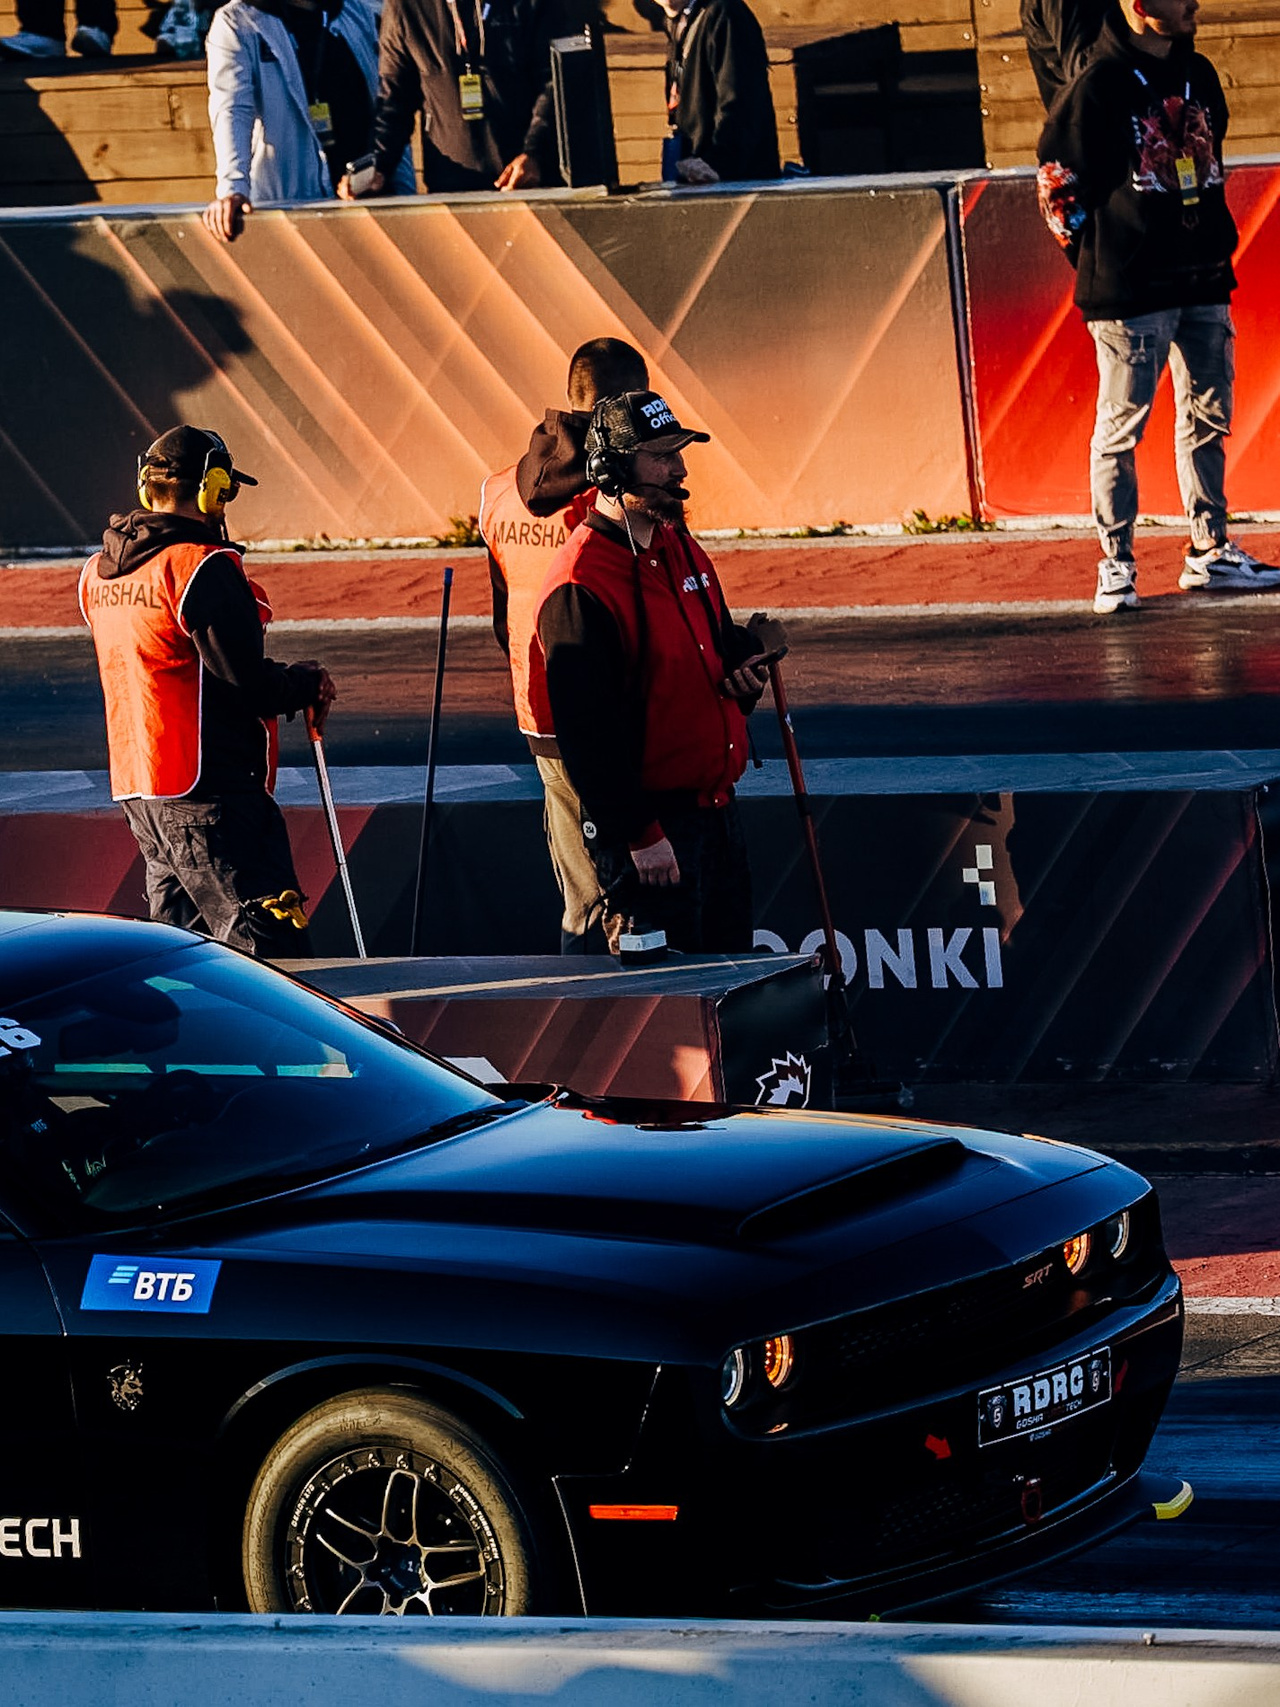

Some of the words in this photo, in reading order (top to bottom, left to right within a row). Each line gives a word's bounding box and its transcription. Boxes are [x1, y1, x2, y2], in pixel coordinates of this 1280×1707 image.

[493, 519, 566, 549] MARSHA
[681, 572, 710, 592] RDC
[752, 927, 1004, 989] ONKI
[133, 1271, 196, 1302] ВТБ
[1022, 1262, 1054, 1289] SRT
[1016, 1399, 1083, 1430] GOSHATECH
[291, 1497, 307, 1528] DEMON
[303, 1483, 316, 1499] 170
[458, 1486, 478, 1511] GOSHA
[476, 1510, 493, 1537] TURBO
[488, 1537, 500, 1559] TECH
